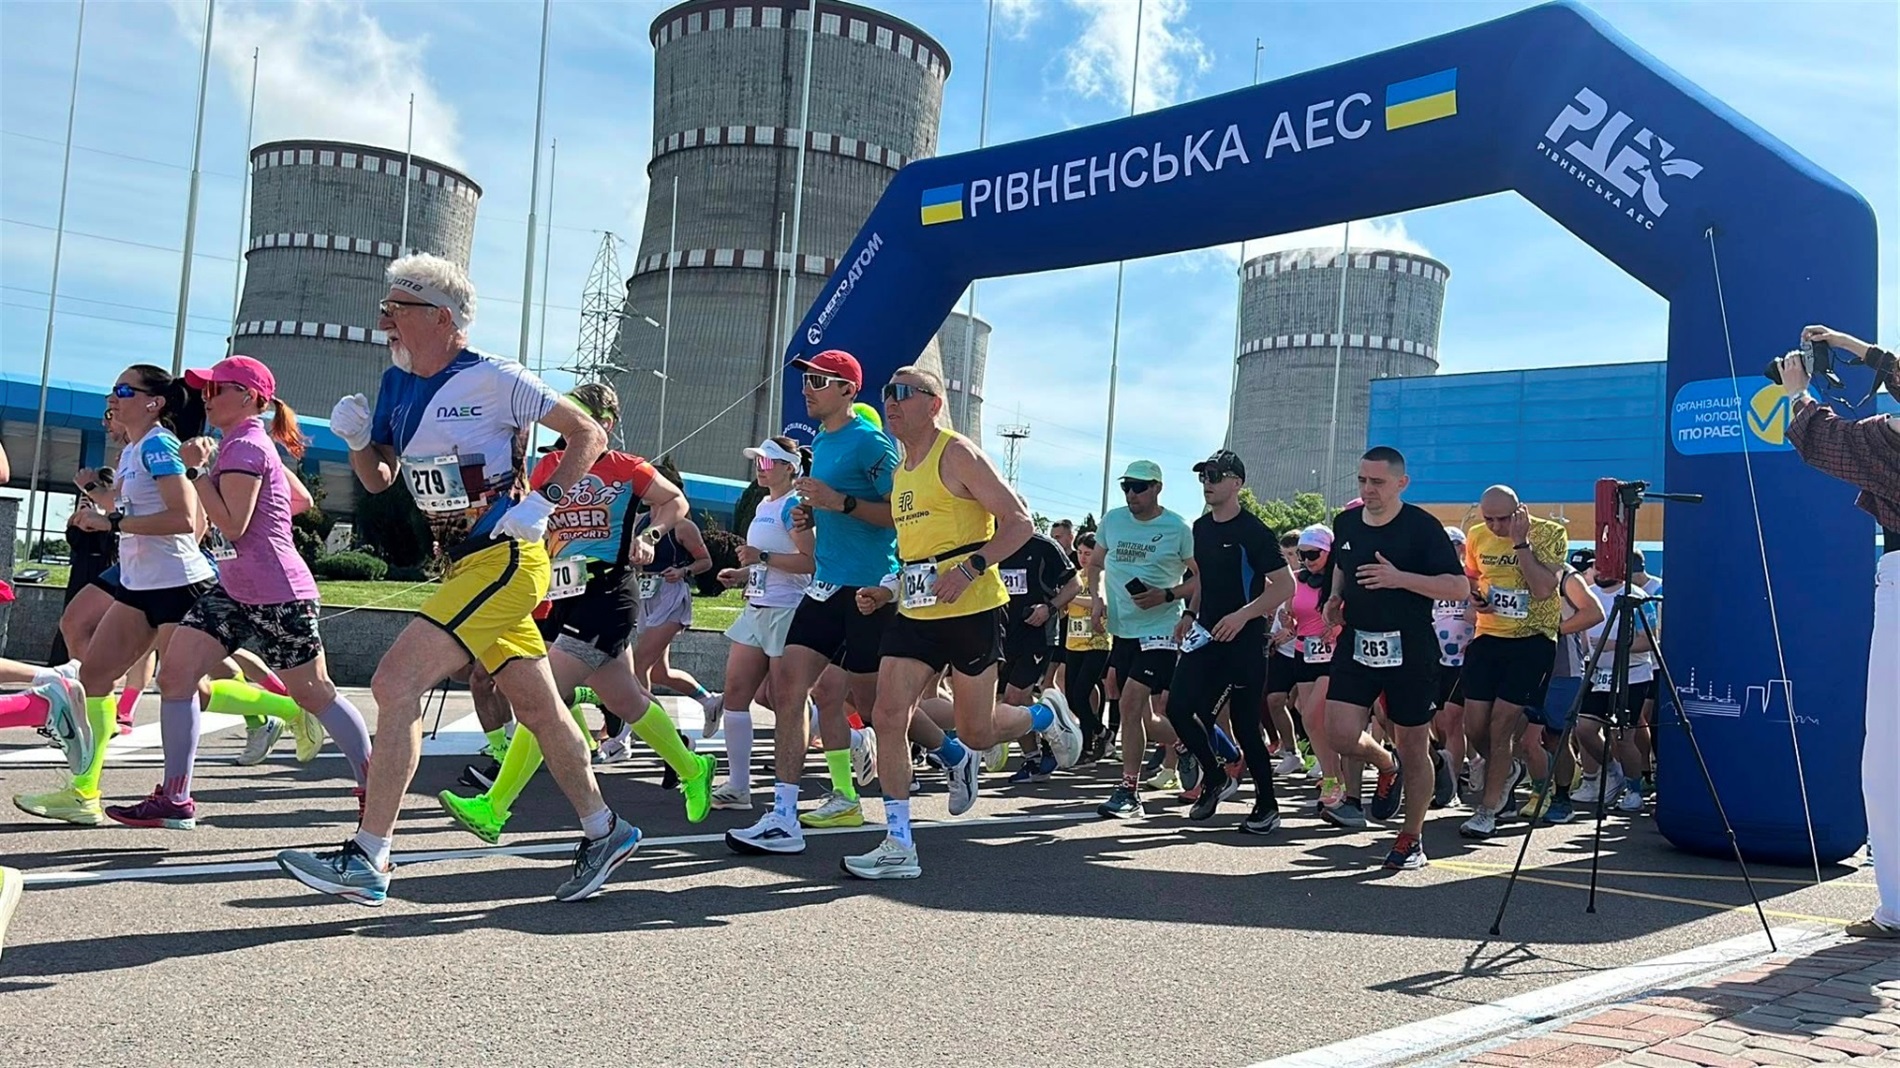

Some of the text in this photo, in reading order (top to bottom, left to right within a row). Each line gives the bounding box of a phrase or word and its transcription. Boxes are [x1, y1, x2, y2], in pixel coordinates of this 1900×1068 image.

[969, 92, 1373, 218] РІВНЕНСЬКА АЕС
[1536, 141, 1655, 231] РІВНЕНСЬКА АЕС
[1675, 396, 1742, 413] ОРГАНІЗАЦІЯ
[1695, 410, 1741, 424] МОЛОД
[1703, 424, 1741, 438] РАЕС
[411, 469, 446, 495] 279
[553, 566, 572, 586] 70
[1493, 592, 1518, 610] 254
[1310, 640, 1332, 656] 226
[1362, 639, 1389, 658] 263
